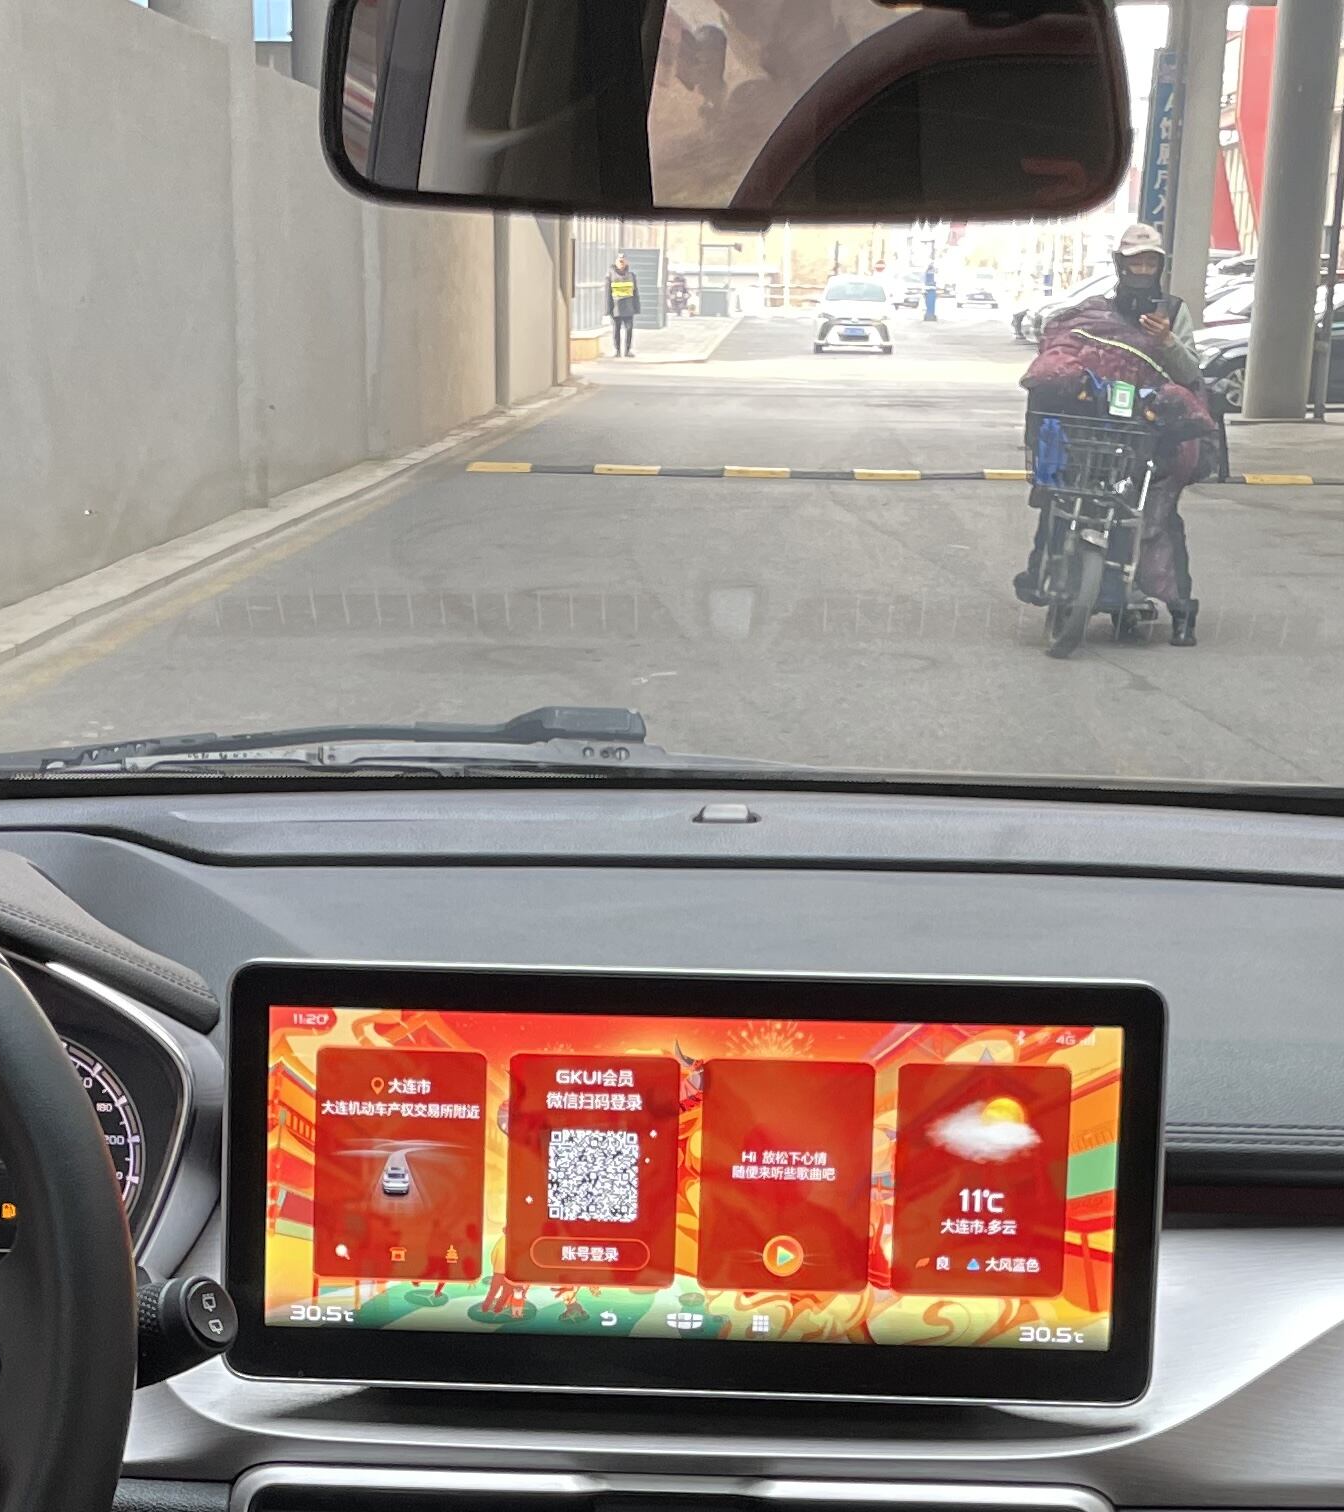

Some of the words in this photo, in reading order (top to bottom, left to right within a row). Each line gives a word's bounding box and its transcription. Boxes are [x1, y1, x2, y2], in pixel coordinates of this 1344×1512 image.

[1056, 1035, 1076, 1045] 4G
[387, 1078, 431, 1094] 大连市
[555, 1069, 634, 1087] GKUI会员
[321, 1100, 480, 1120] 大连机动车产权交易所附近
[546, 1092, 643, 1111] 微信扫码登录
[762, 1150, 827, 1166] 放松下心情
[731, 1165, 836, 1181] 随便来听些歌曲吧
[561, 1245, 620, 1262] 账号登录
[985, 1256, 1040, 1273] 大风蓝色
